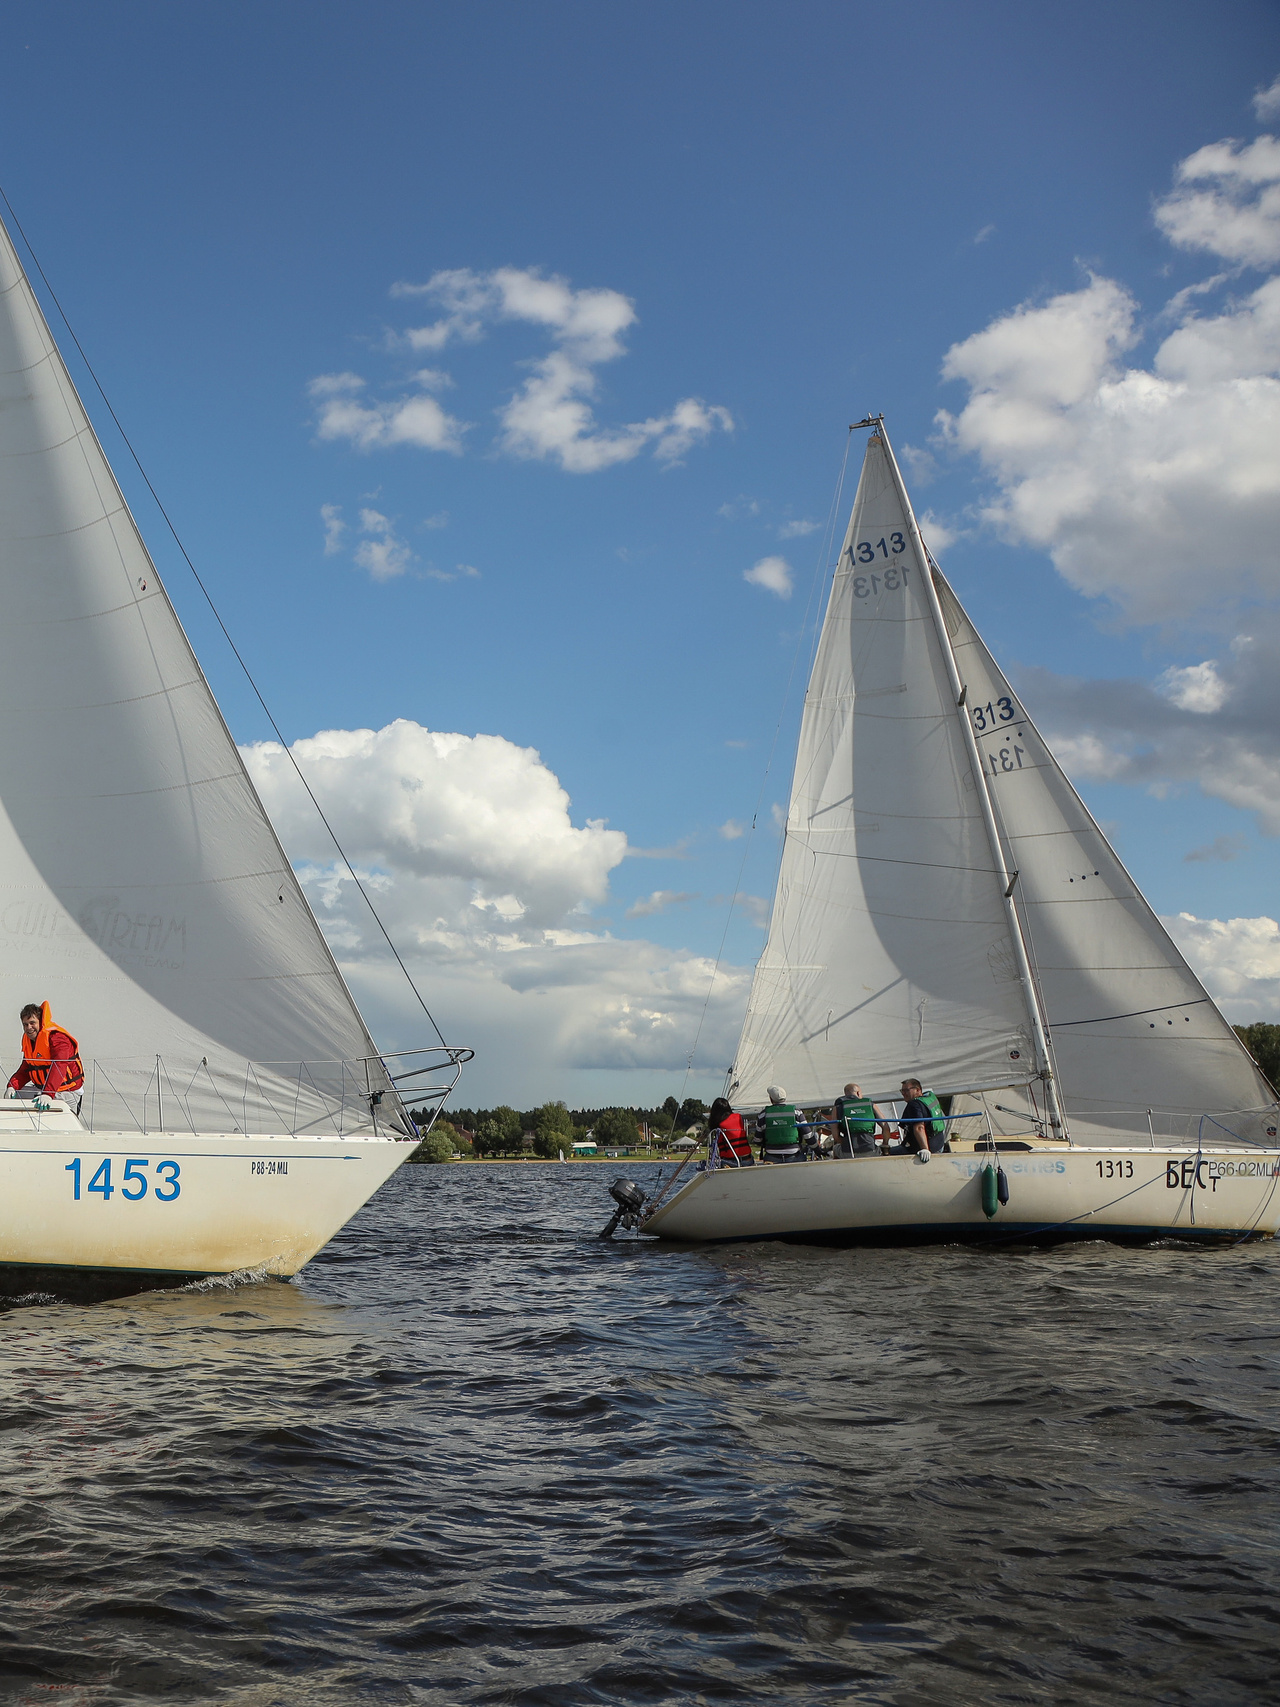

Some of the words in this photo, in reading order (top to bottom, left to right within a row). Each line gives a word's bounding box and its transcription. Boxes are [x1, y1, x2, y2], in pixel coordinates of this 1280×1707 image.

[844, 531, 906, 566] 1313
[65, 1158, 181, 1202] 1453
[1095, 1160, 1134, 1178] 1313
